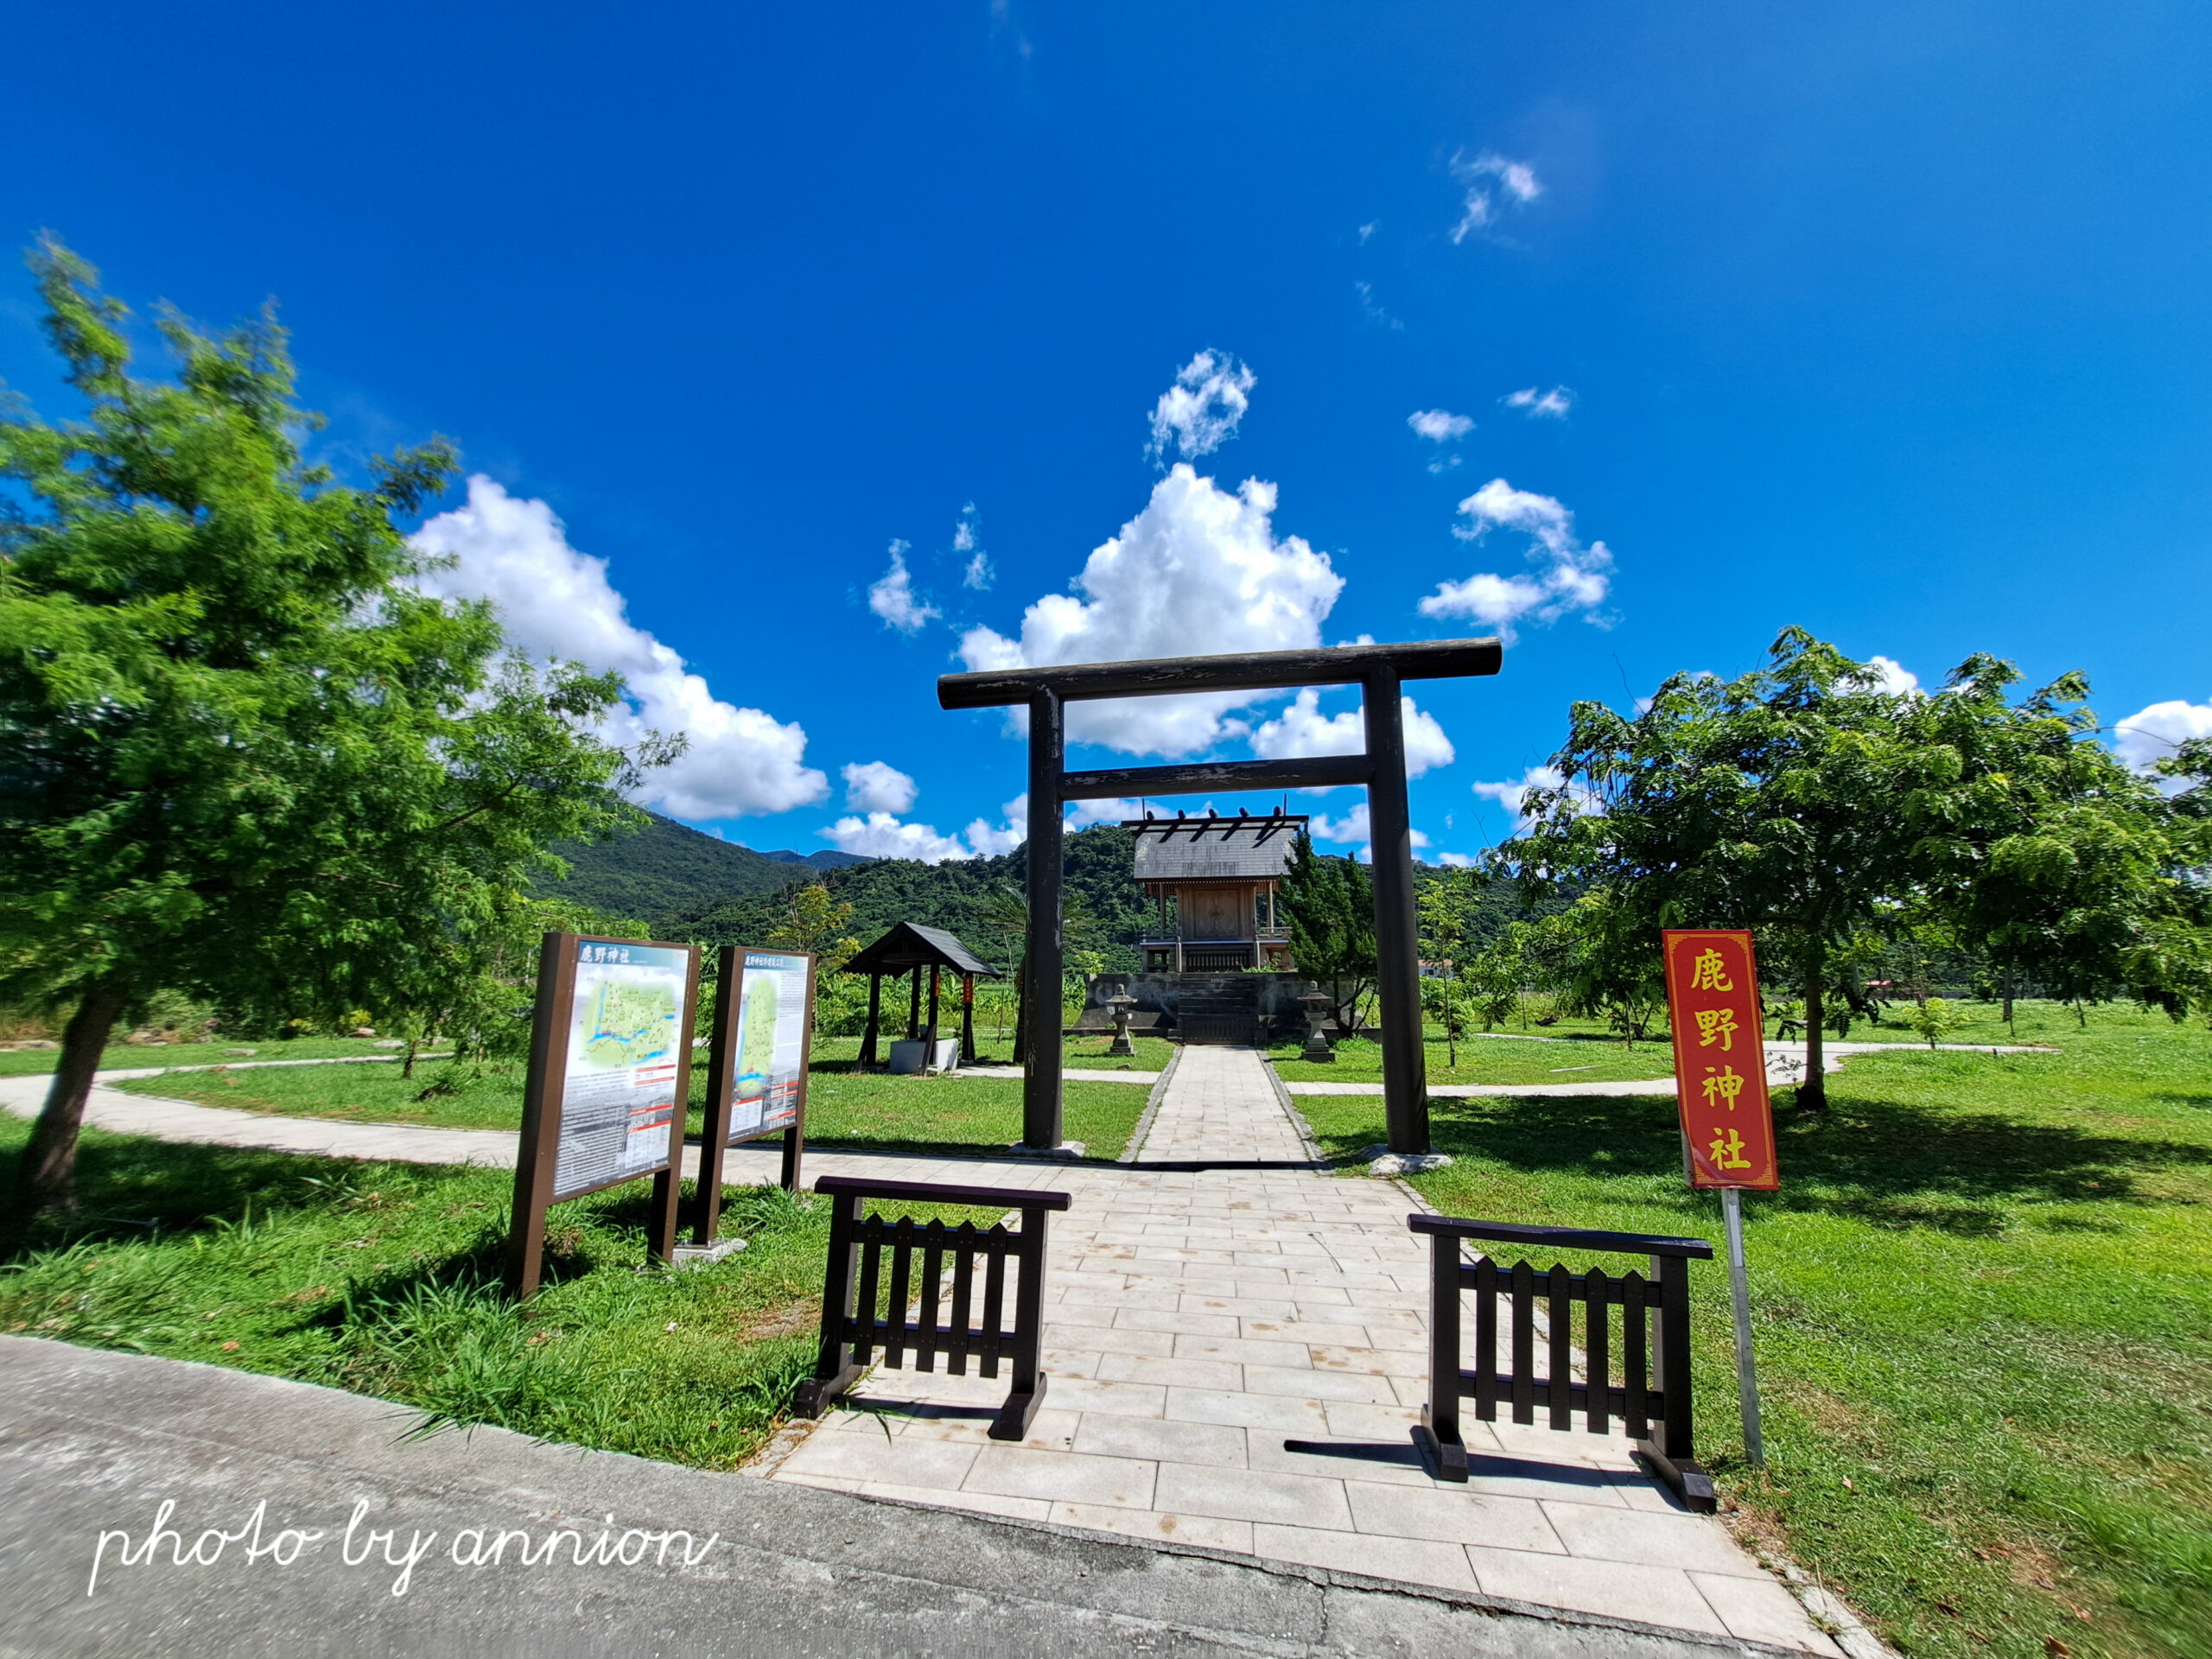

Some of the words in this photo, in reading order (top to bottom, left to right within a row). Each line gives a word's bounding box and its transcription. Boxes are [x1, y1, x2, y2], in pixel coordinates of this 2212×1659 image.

[580, 944, 630, 963] 鹿野神社
[1691, 948, 1752, 1171] 鹿野神社
